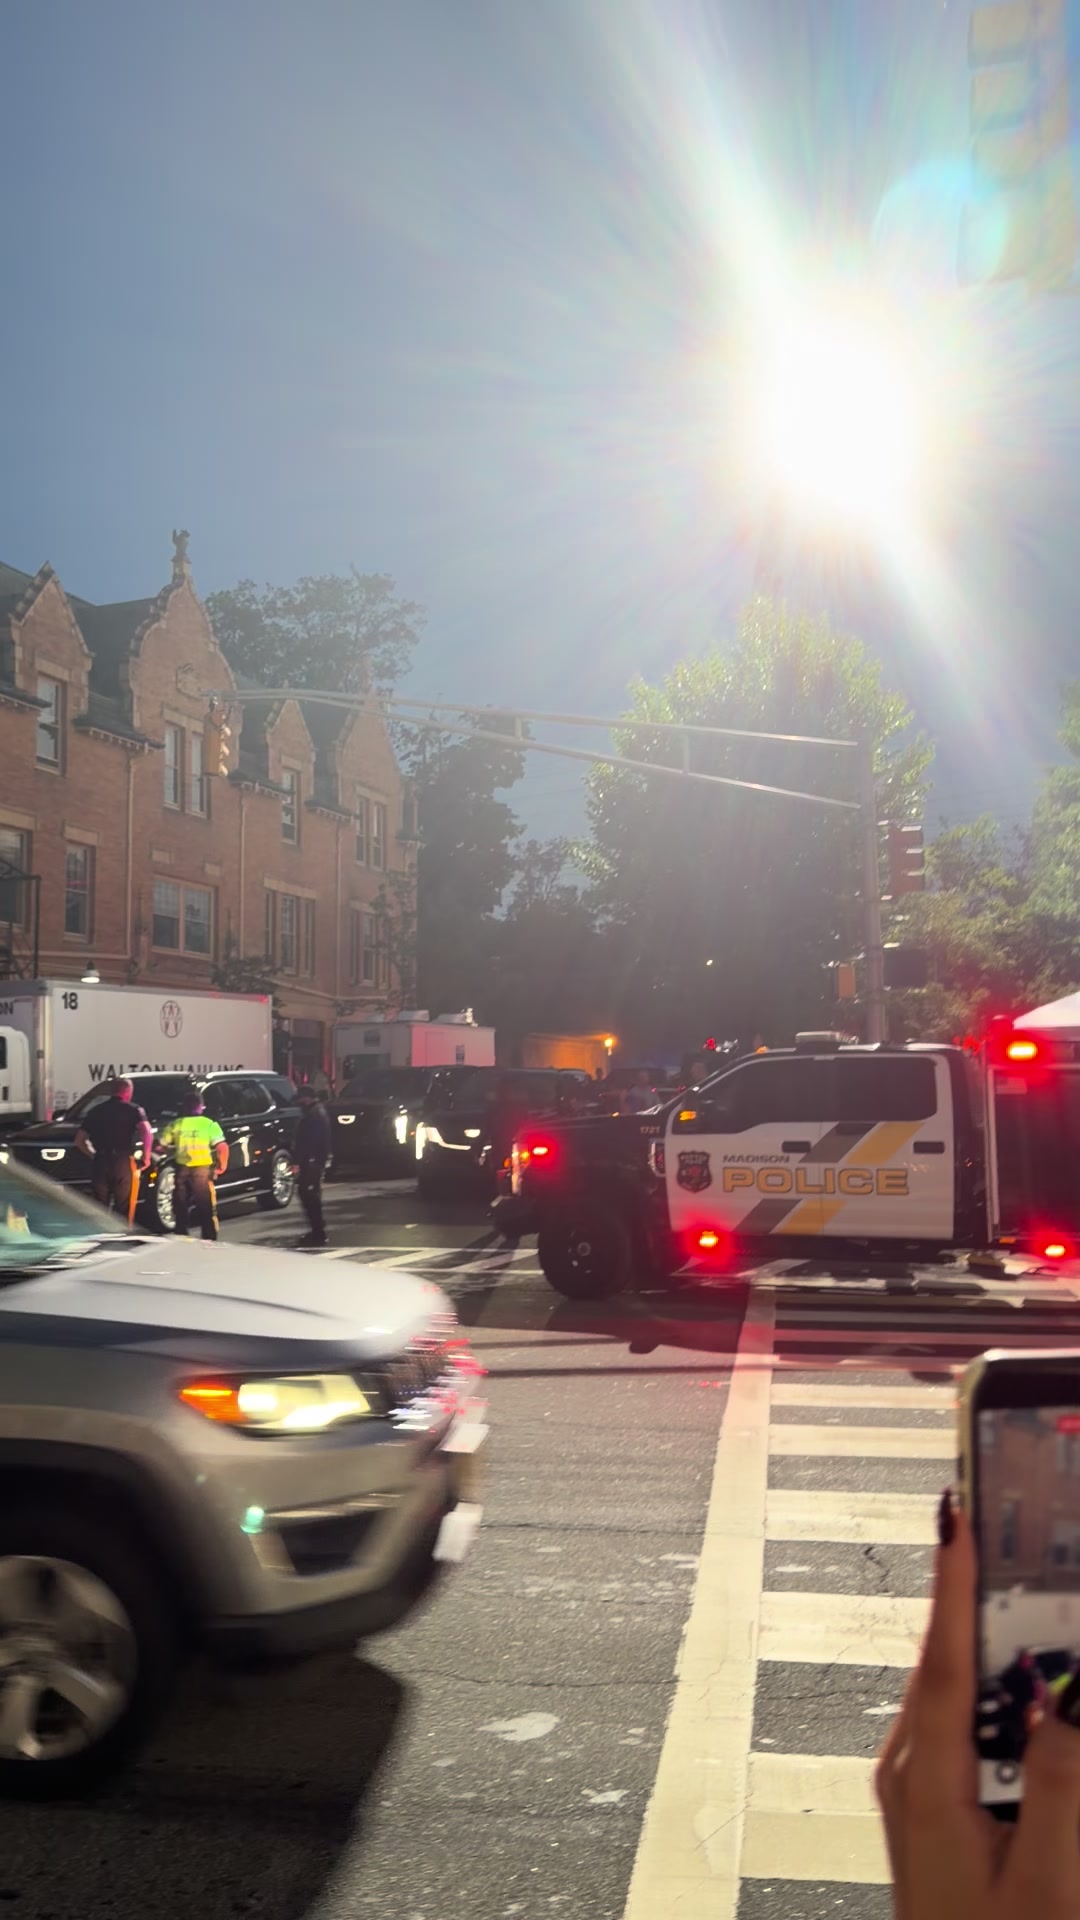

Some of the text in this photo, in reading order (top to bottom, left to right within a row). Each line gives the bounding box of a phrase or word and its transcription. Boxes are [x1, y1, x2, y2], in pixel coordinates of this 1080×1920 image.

[61, 992, 79, 1010] 18
[722, 1154, 790, 1164] MADISON
[722, 1166, 909, 1196] POLICE
